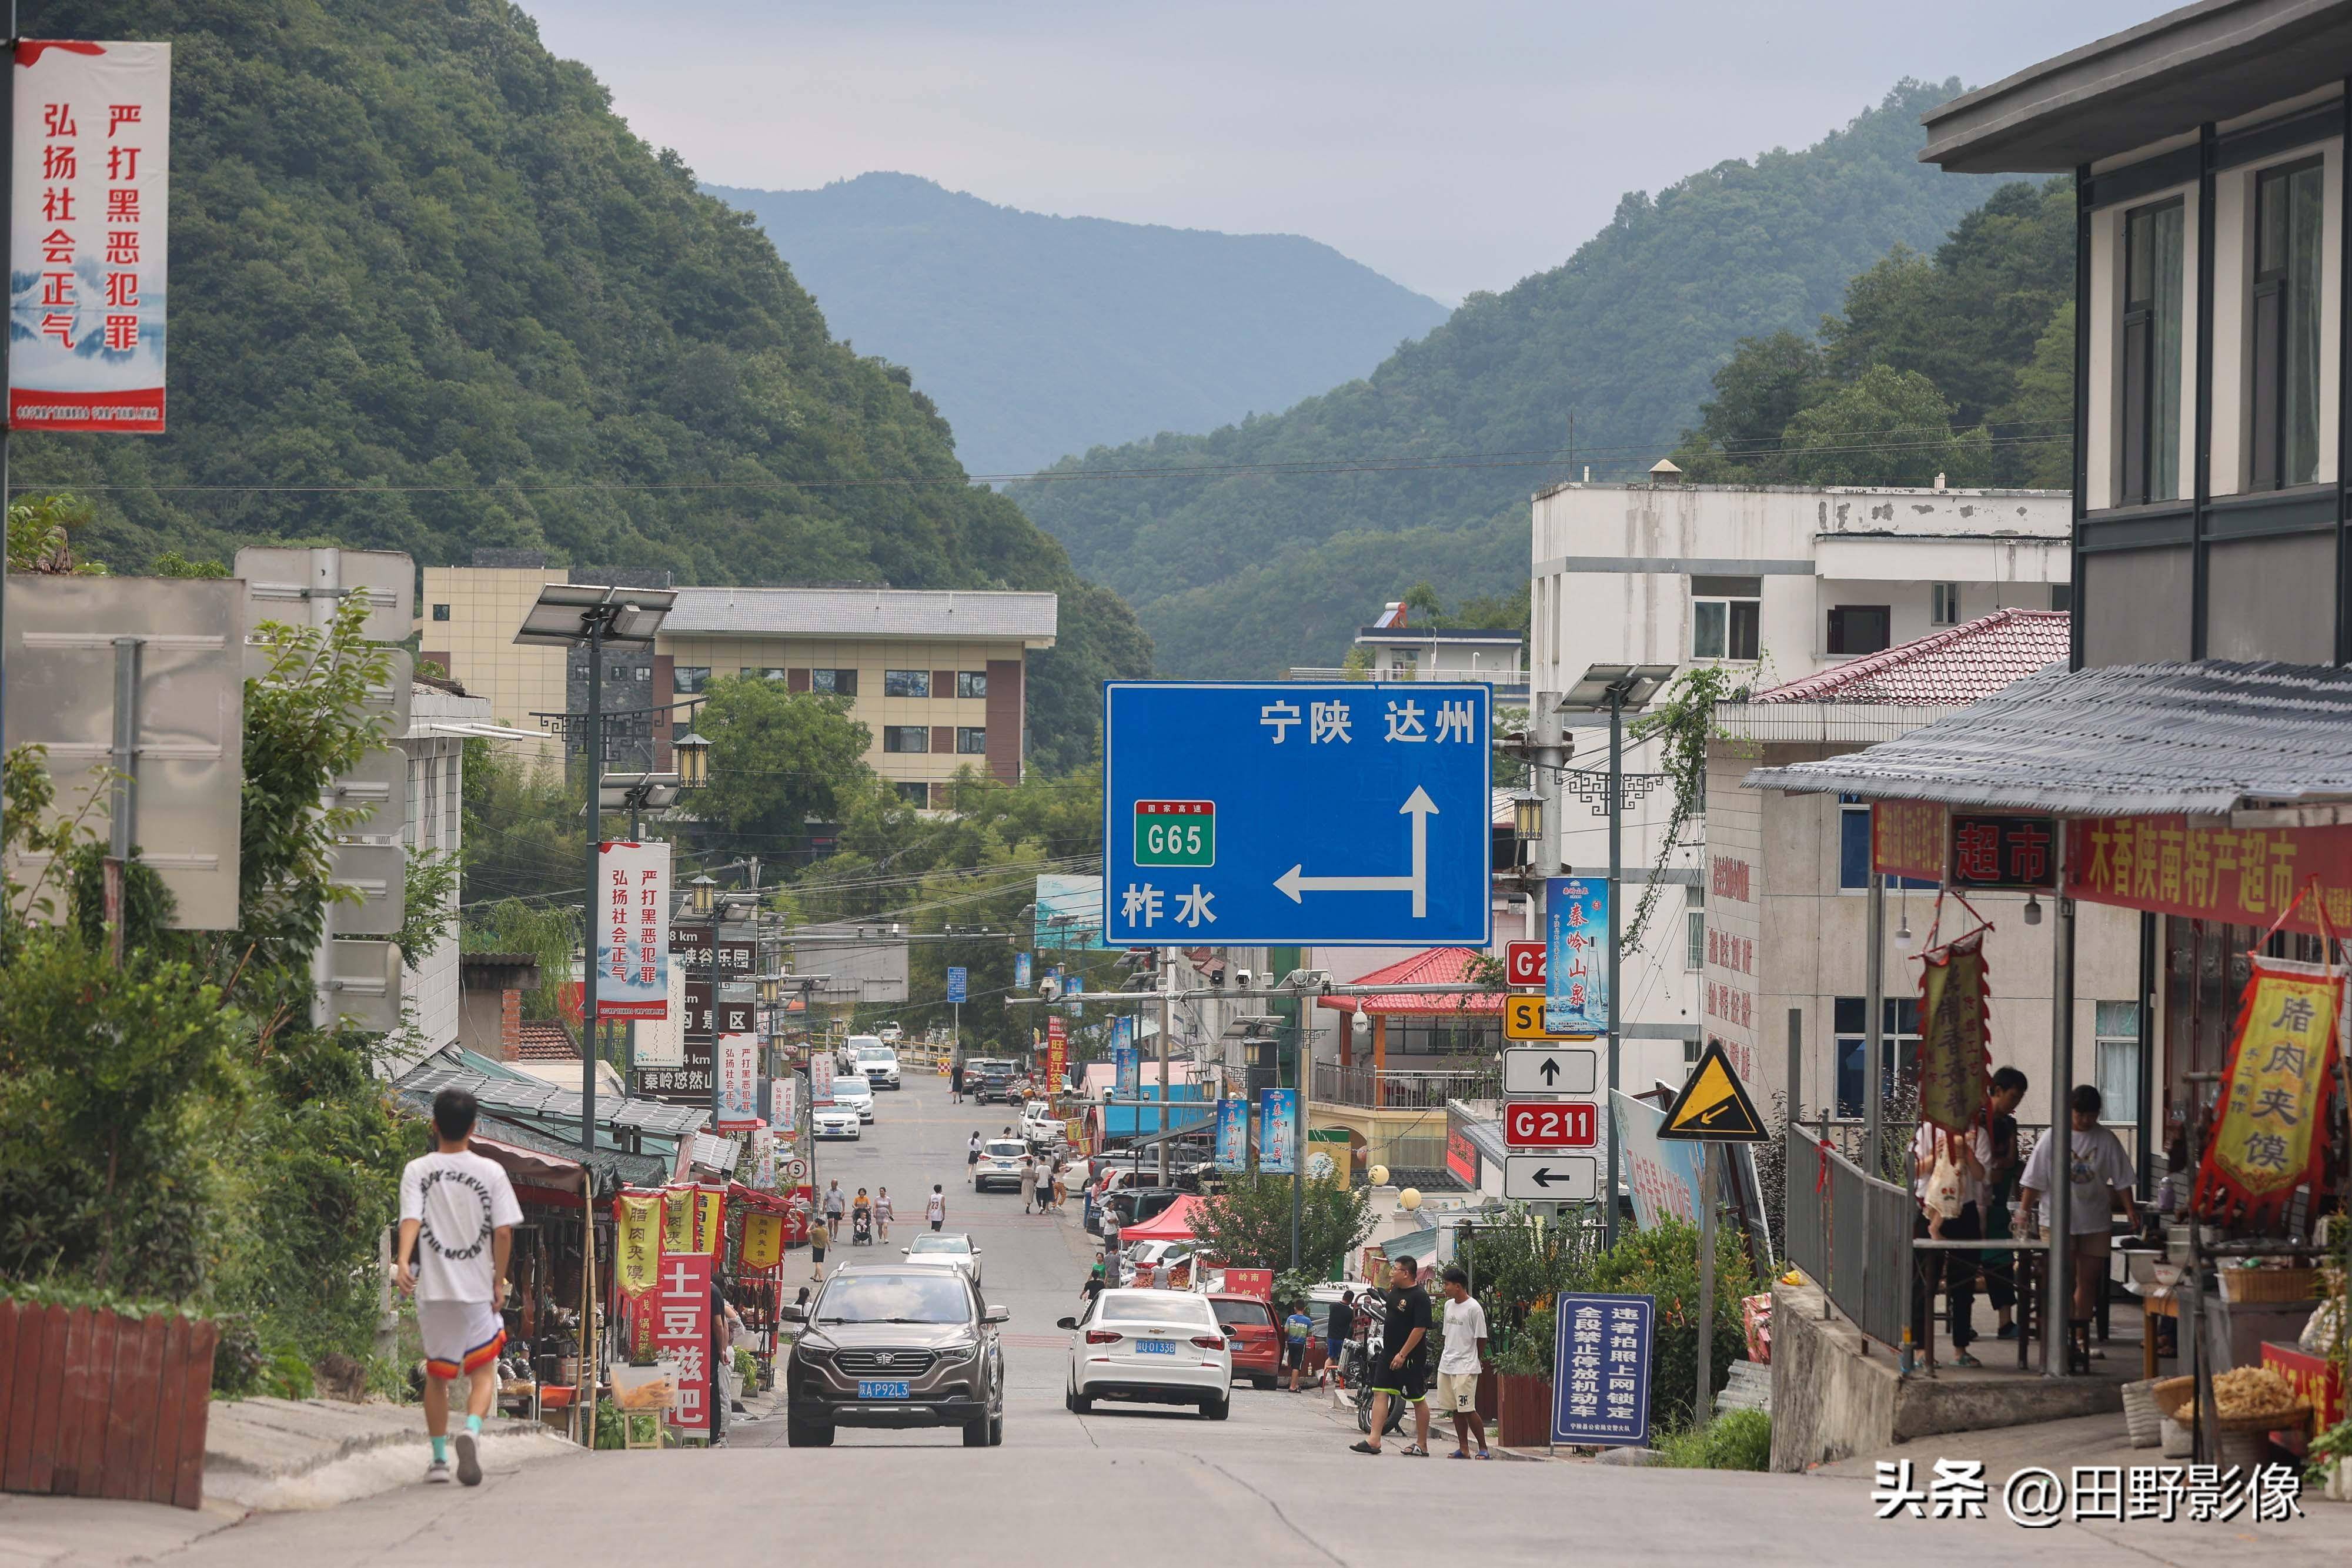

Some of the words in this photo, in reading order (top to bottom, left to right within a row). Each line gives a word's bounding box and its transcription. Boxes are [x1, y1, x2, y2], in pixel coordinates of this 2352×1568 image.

[42, 103, 77, 349] 弘扬社会正气
[105, 104, 141, 350] 严打黑恶犯罪
[1260, 700, 1352, 744] 宁陕
[1384, 700, 1475, 744] 达州
[1148, 804, 1202, 813] 国家高速
[1148, 824, 1201, 855] G65
[1955, 823, 2050, 882] 超市
[2089, 818, 2297, 917] 木香陕南特产超市
[612, 870, 628, 982] 弘扬社会正气
[640, 870, 657, 983] 严打黑恶犯罪
[680, 931, 697, 941] km
[1121, 883, 1218, 928] 柞水
[1567, 902, 1589, 1007] 秦岭山泉
[692, 1054, 710, 1065] km
[725, 1048, 734, 1111] 弘扬社会正气
[741, 1048, 751, 1111] 严打黑恶犯罪
[2244, 997, 2316, 1172] 腊肉夹馍
[1227, 1110, 1237, 1159] 秦岭山泉
[1272, 1102, 1284, 1159] 秦岭山泉
[1515, 1112, 1587, 1138] G211
[794, 1164, 800, 1174] 5
[626, 1207, 647, 1280] 腊肉夹馍
[1238, 1272, 1259, 1282] 岭南
[1569, 1306, 1603, 1417] 全段禁止停放机动车
[1606, 1308, 1639, 1419] 违者拍照上网锁定
